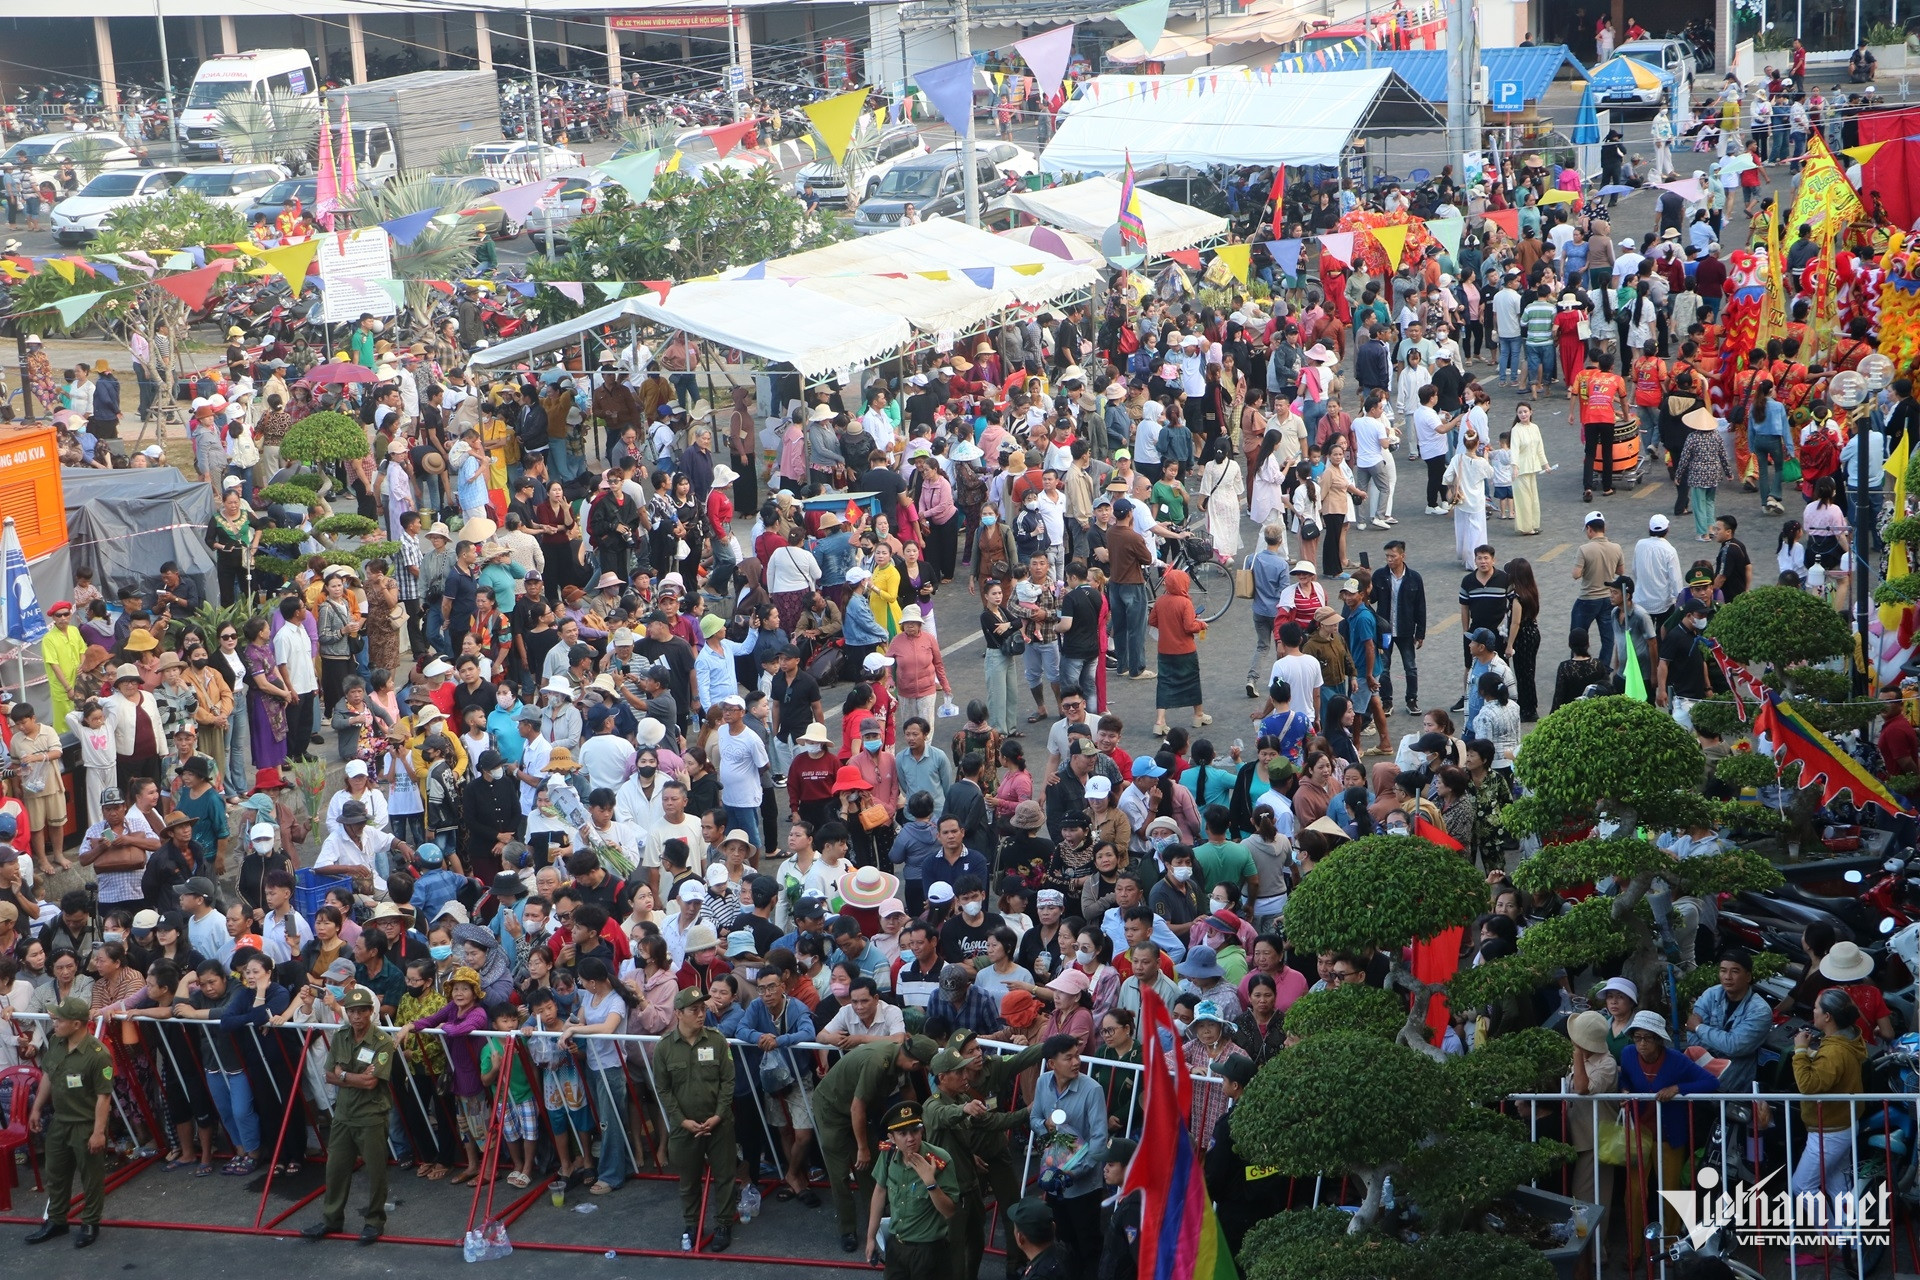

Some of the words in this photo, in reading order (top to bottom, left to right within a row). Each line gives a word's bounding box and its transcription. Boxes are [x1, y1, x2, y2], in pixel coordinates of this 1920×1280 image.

[666, 18, 681, 27] PHỤC
[1501, 83, 1516, 102] P
[13, 450, 28, 464] 400
[28, 445, 46, 461] KVA
[20, 607, 42, 620] VNP
